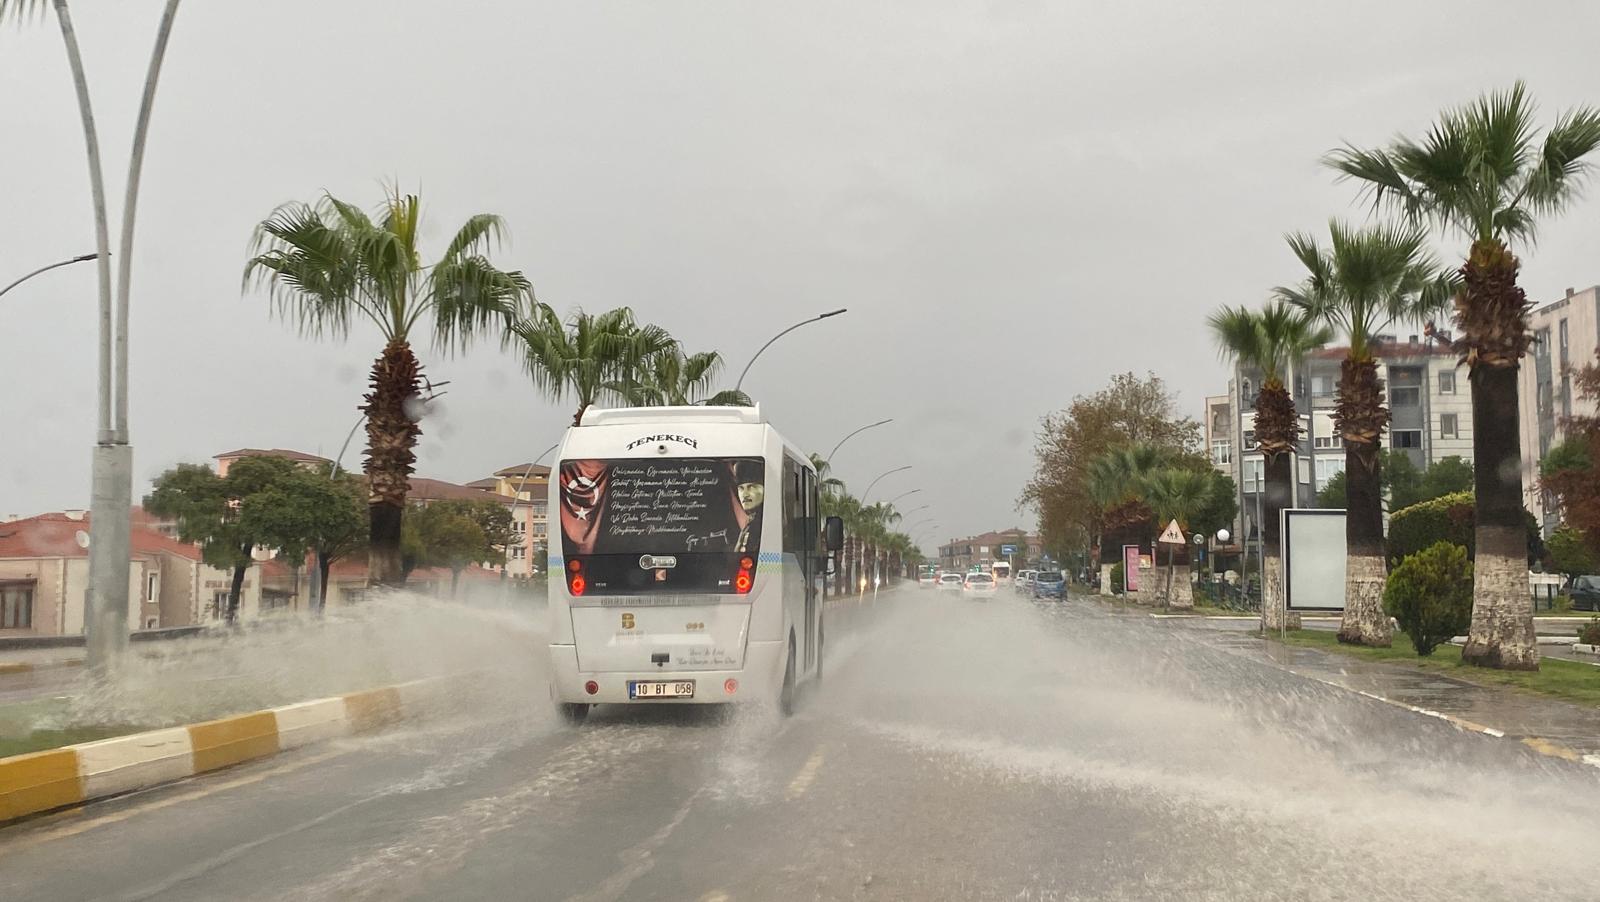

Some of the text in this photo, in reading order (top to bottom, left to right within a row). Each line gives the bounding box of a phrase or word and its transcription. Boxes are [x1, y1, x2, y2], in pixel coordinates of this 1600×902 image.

[626, 434, 697, 450] TENEKECİ
[637, 683, 692, 695] 10 BT 058
